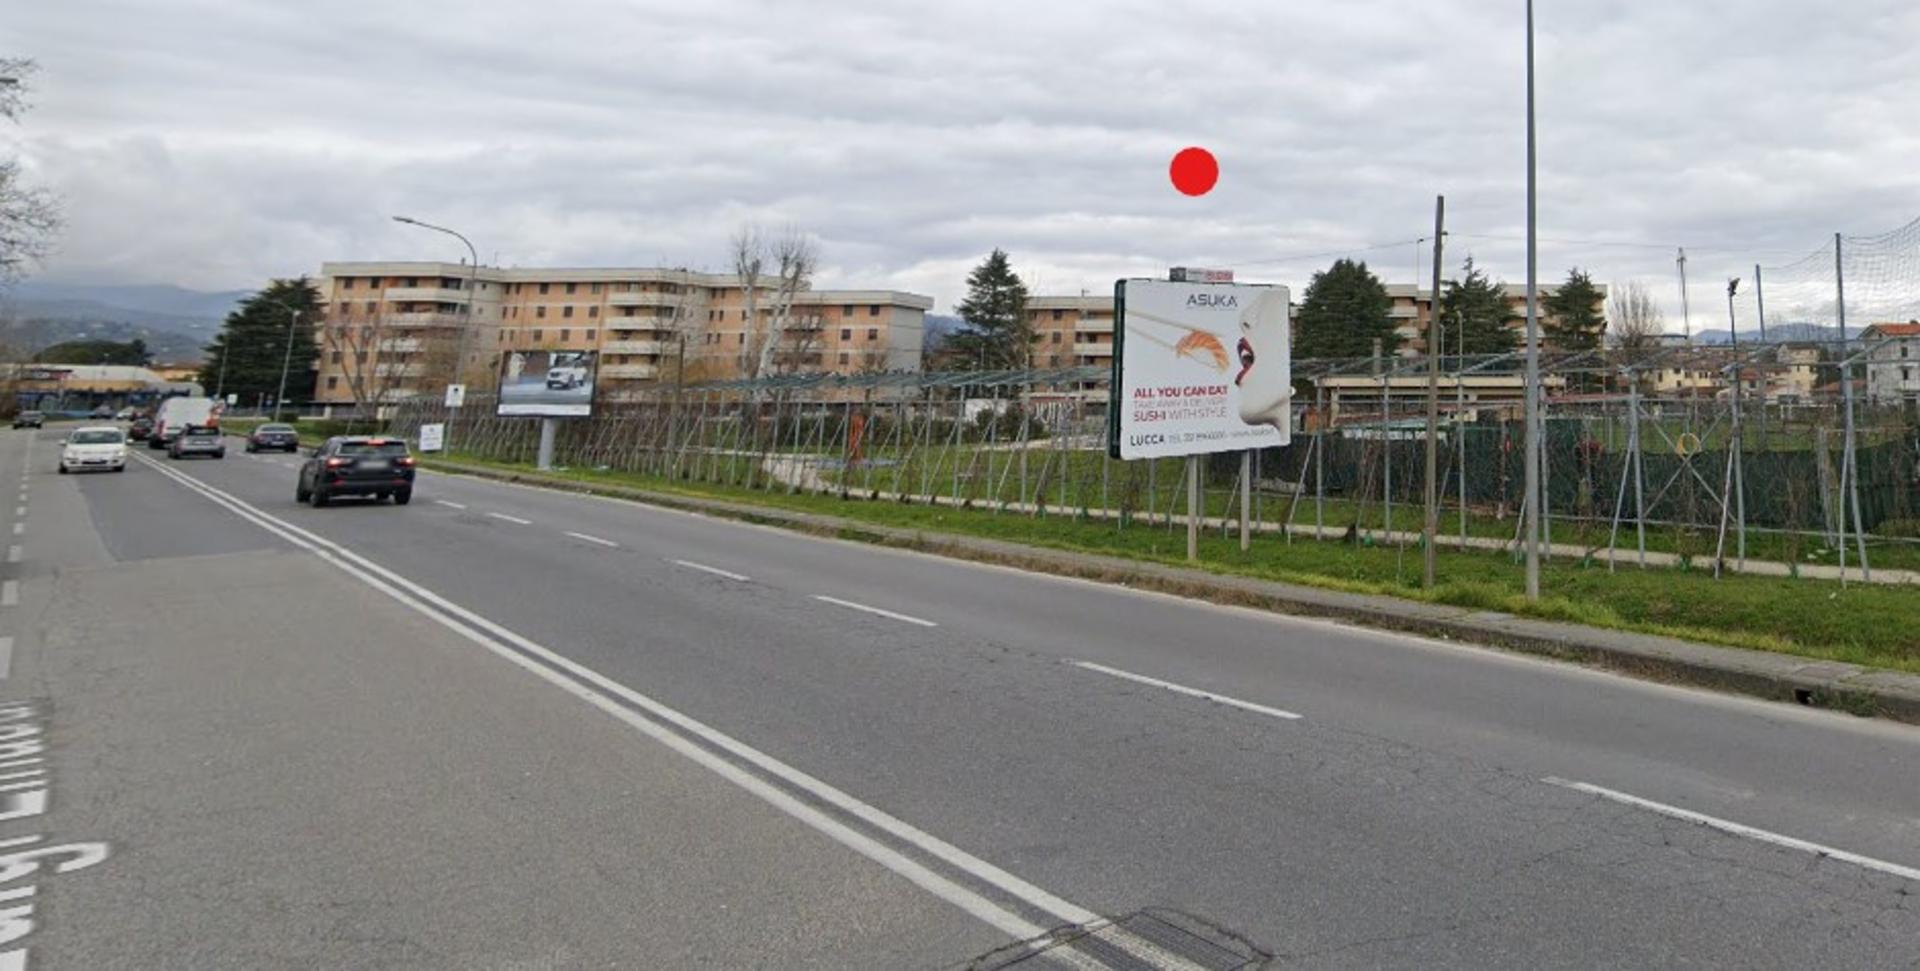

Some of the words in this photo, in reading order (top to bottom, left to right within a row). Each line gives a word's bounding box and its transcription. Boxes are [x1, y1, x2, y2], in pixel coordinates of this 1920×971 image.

[1185, 293, 1238, 307] ASUKA
[1134, 387, 1155, 398] ALL
[1157, 386, 1181, 398] YOU
[1183, 385, 1206, 397] CAN
[1208, 385, 1228, 396] EAT
[1134, 410, 1166, 422] SUSHI
[1168, 408, 1197, 420] WITH
[1198, 406, 1227, 418] STYLE
[1130, 433, 1165, 447] LUCCA
